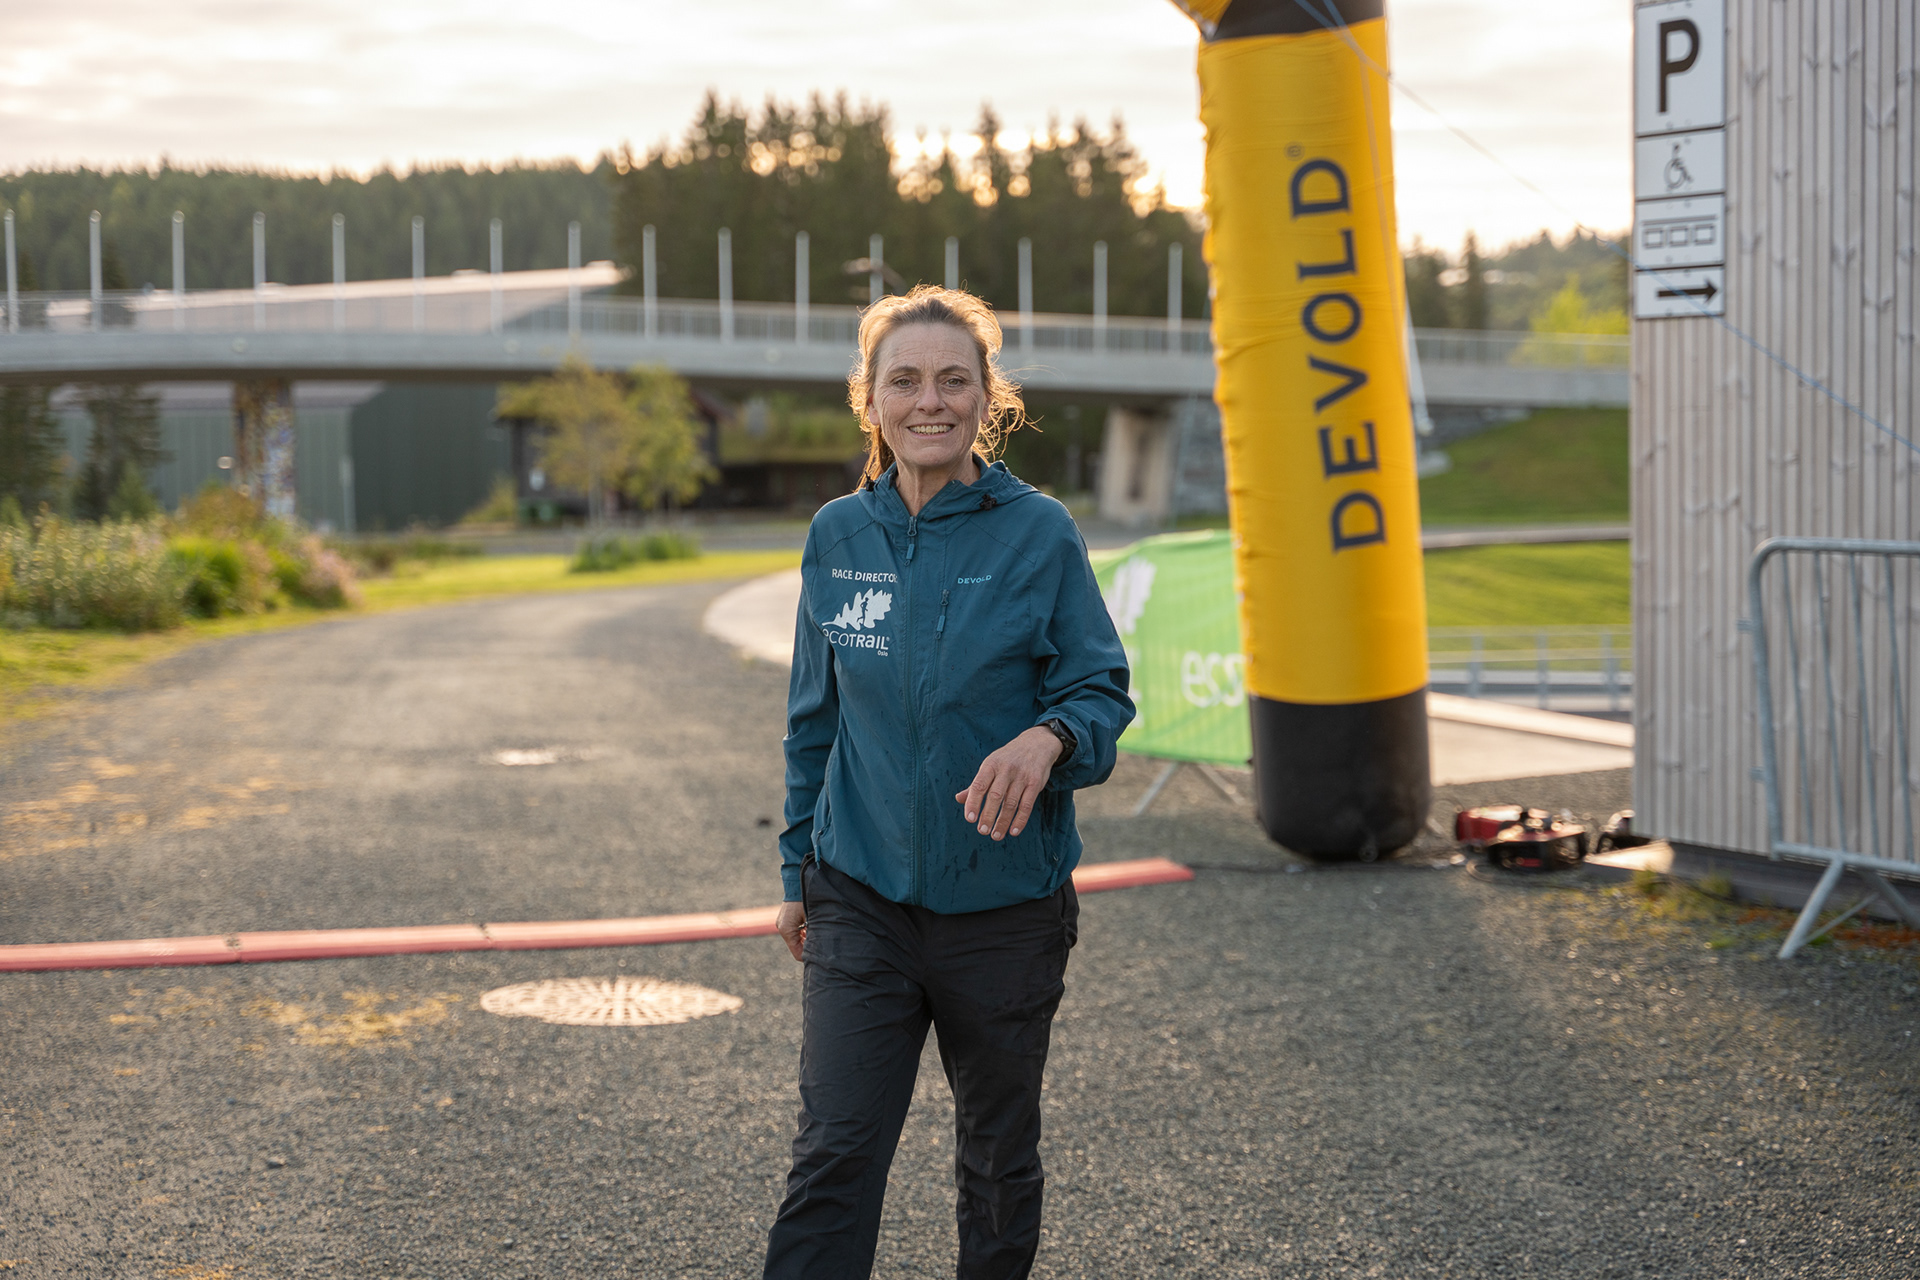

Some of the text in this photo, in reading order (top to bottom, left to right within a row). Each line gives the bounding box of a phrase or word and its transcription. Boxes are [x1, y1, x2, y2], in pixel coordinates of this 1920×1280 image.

[1658, 18, 1700, 113] P
[1288, 157, 1387, 555] DEVOLD
[832, 568, 853, 580] RACE
[957, 574, 992, 584] DEVOLD
